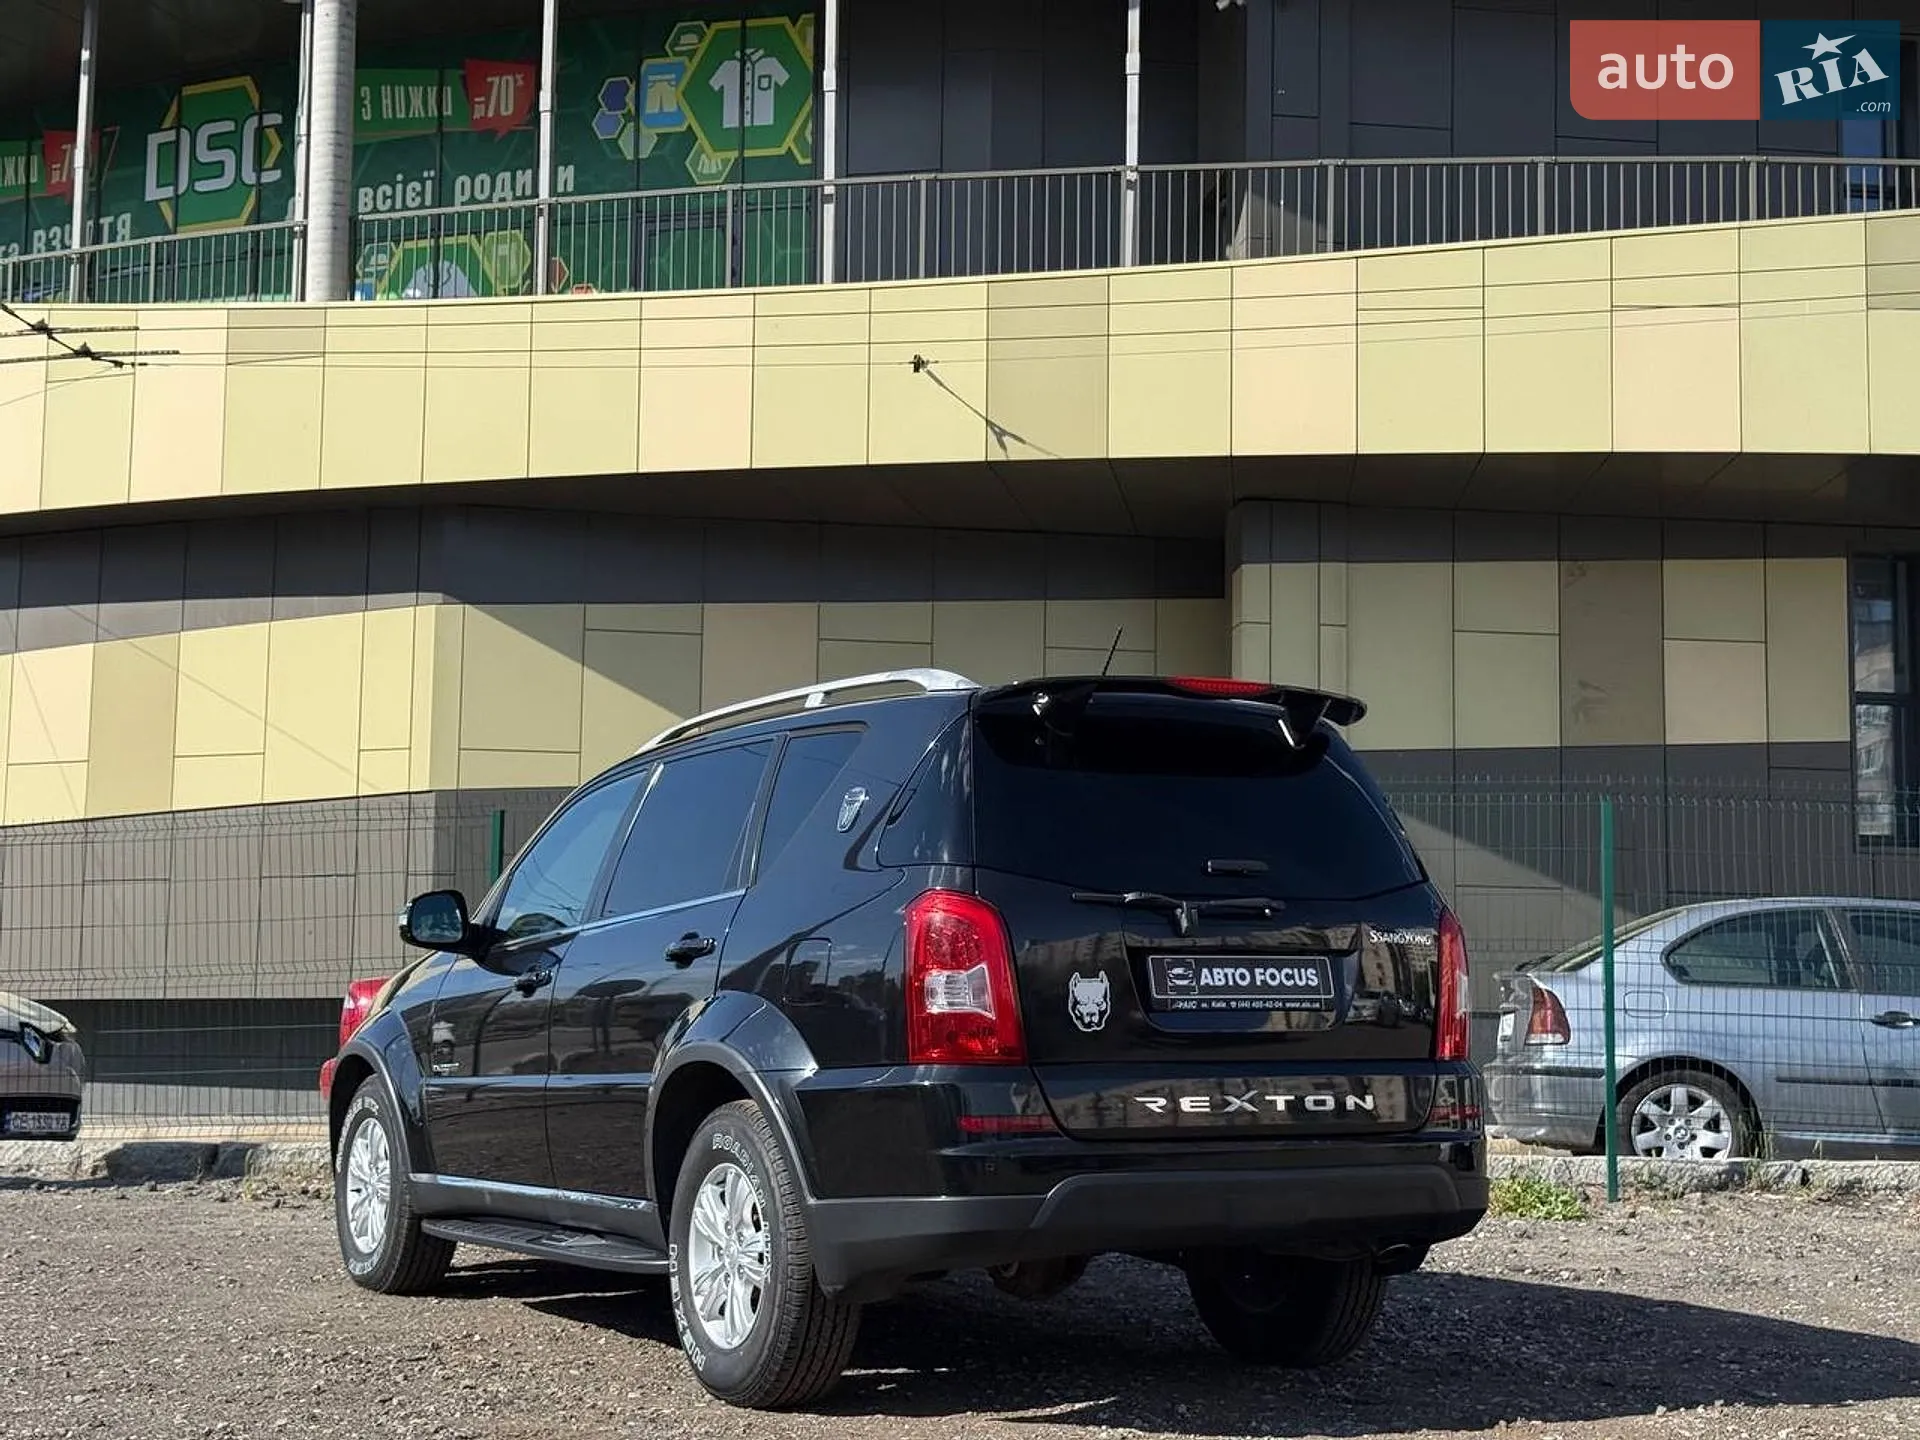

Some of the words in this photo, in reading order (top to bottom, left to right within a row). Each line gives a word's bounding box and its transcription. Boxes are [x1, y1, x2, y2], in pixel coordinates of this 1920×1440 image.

[144, 112, 283, 202] DSC
[358, 170, 436, 213] всієї
[453, 164, 575, 208] родии
[1253, 967, 1319, 987] FOCUS
[1133, 1090, 1375, 1113] REXTON
